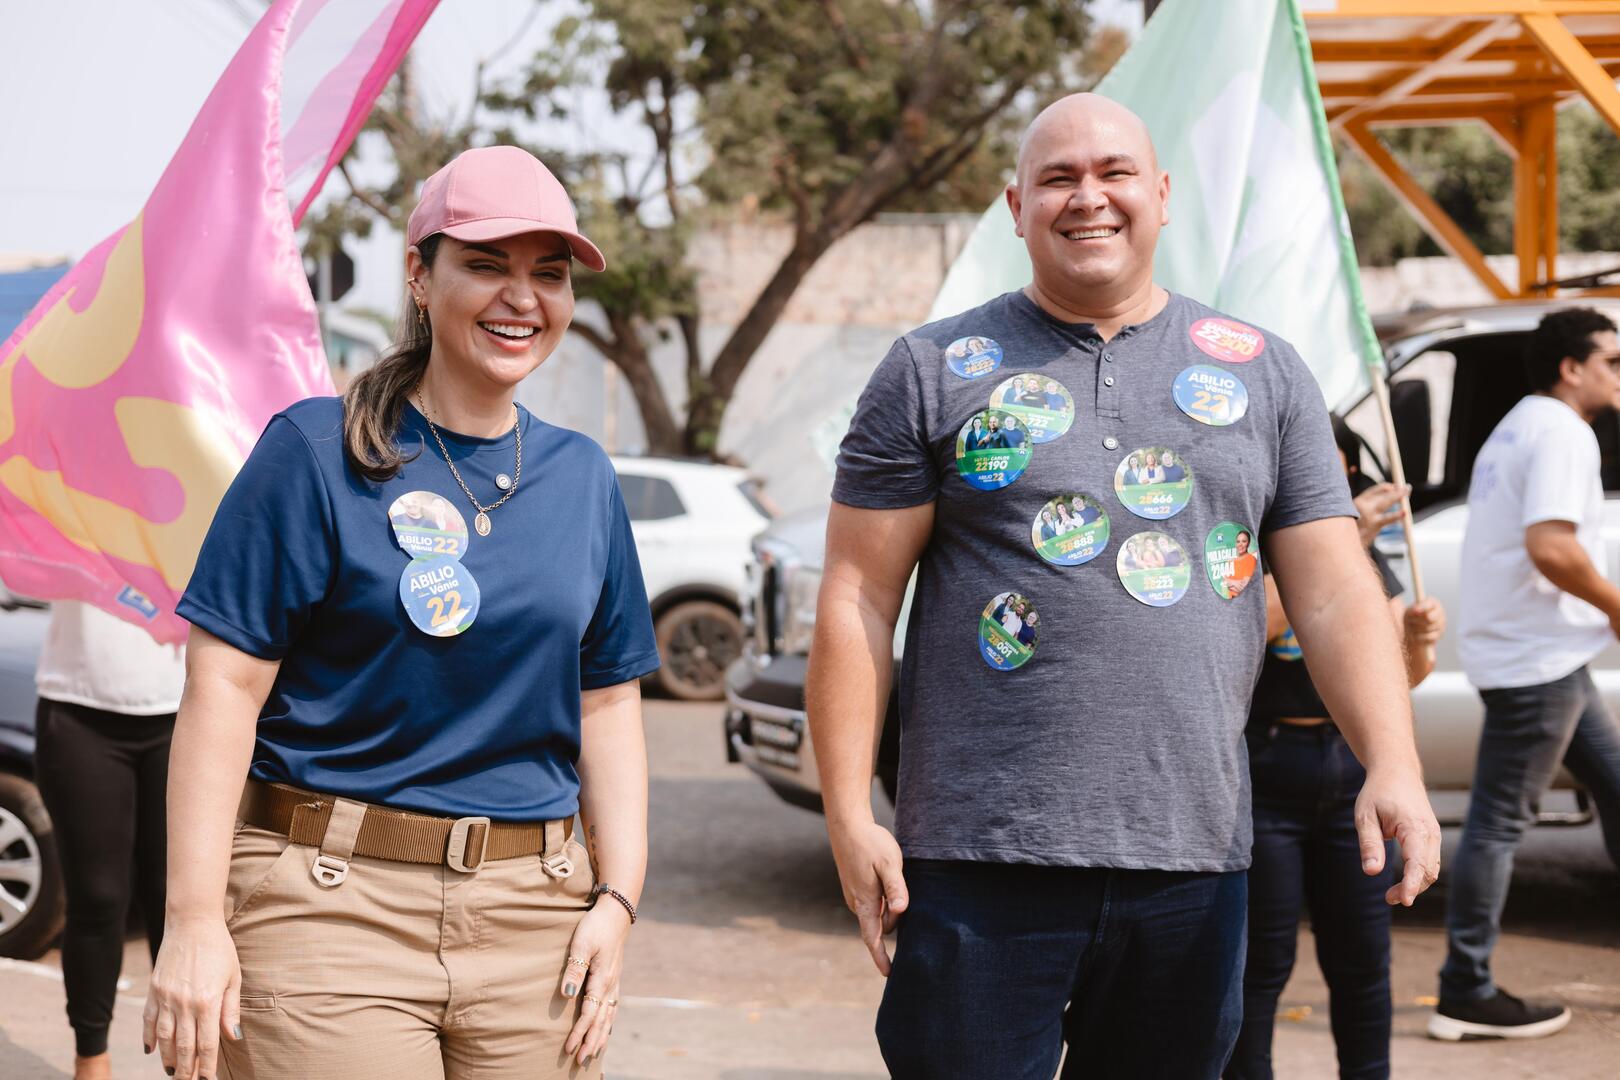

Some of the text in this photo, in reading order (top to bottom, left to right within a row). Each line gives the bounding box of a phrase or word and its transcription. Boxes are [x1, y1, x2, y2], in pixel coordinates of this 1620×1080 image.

[1195, 330, 1255, 356] 22300
[1188, 372, 1235, 389] ABILIO
[1191, 391, 1229, 412] 22
[975, 460, 1009, 472] 22190
[992, 472, 1004, 481] 22
[398, 534, 459, 555] ABILIO 22
[410, 565, 454, 592] ABILIO
[429, 579, 459, 595] Vânia
[426, 590, 462, 626] 22
